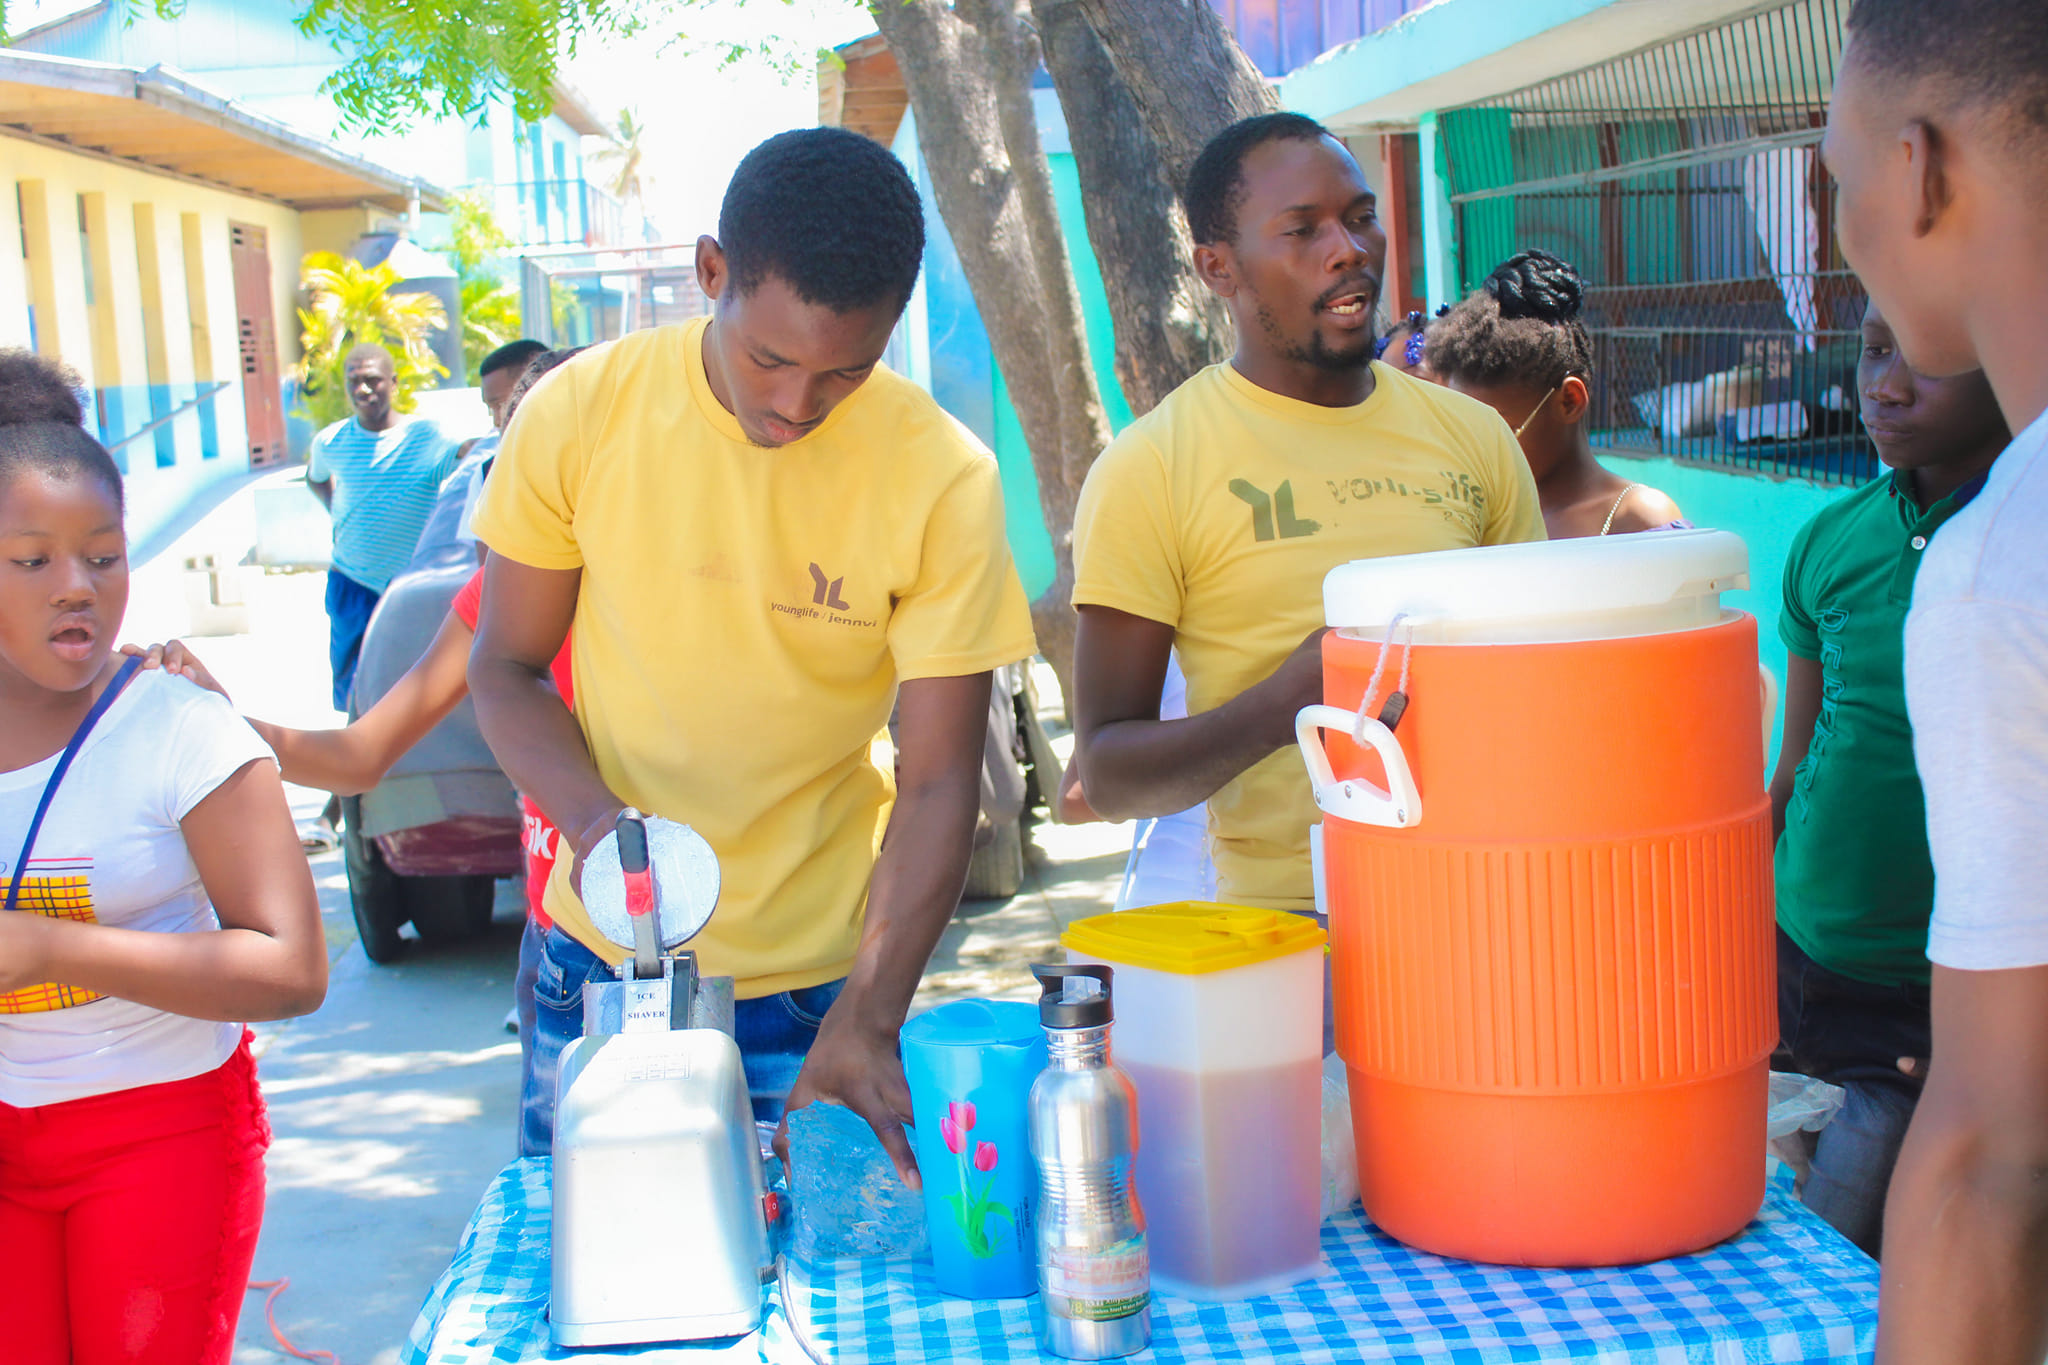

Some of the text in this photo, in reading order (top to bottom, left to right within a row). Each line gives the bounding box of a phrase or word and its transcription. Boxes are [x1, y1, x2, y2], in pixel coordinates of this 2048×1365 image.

[1229, 478, 1322, 542] YL
[808, 562, 850, 611] YL
[770, 602, 819, 620] younglife
[828, 612, 877, 628] jennvi
[637, 992, 656, 1000] ICE
[627, 1010, 665, 1020] SHAVER
